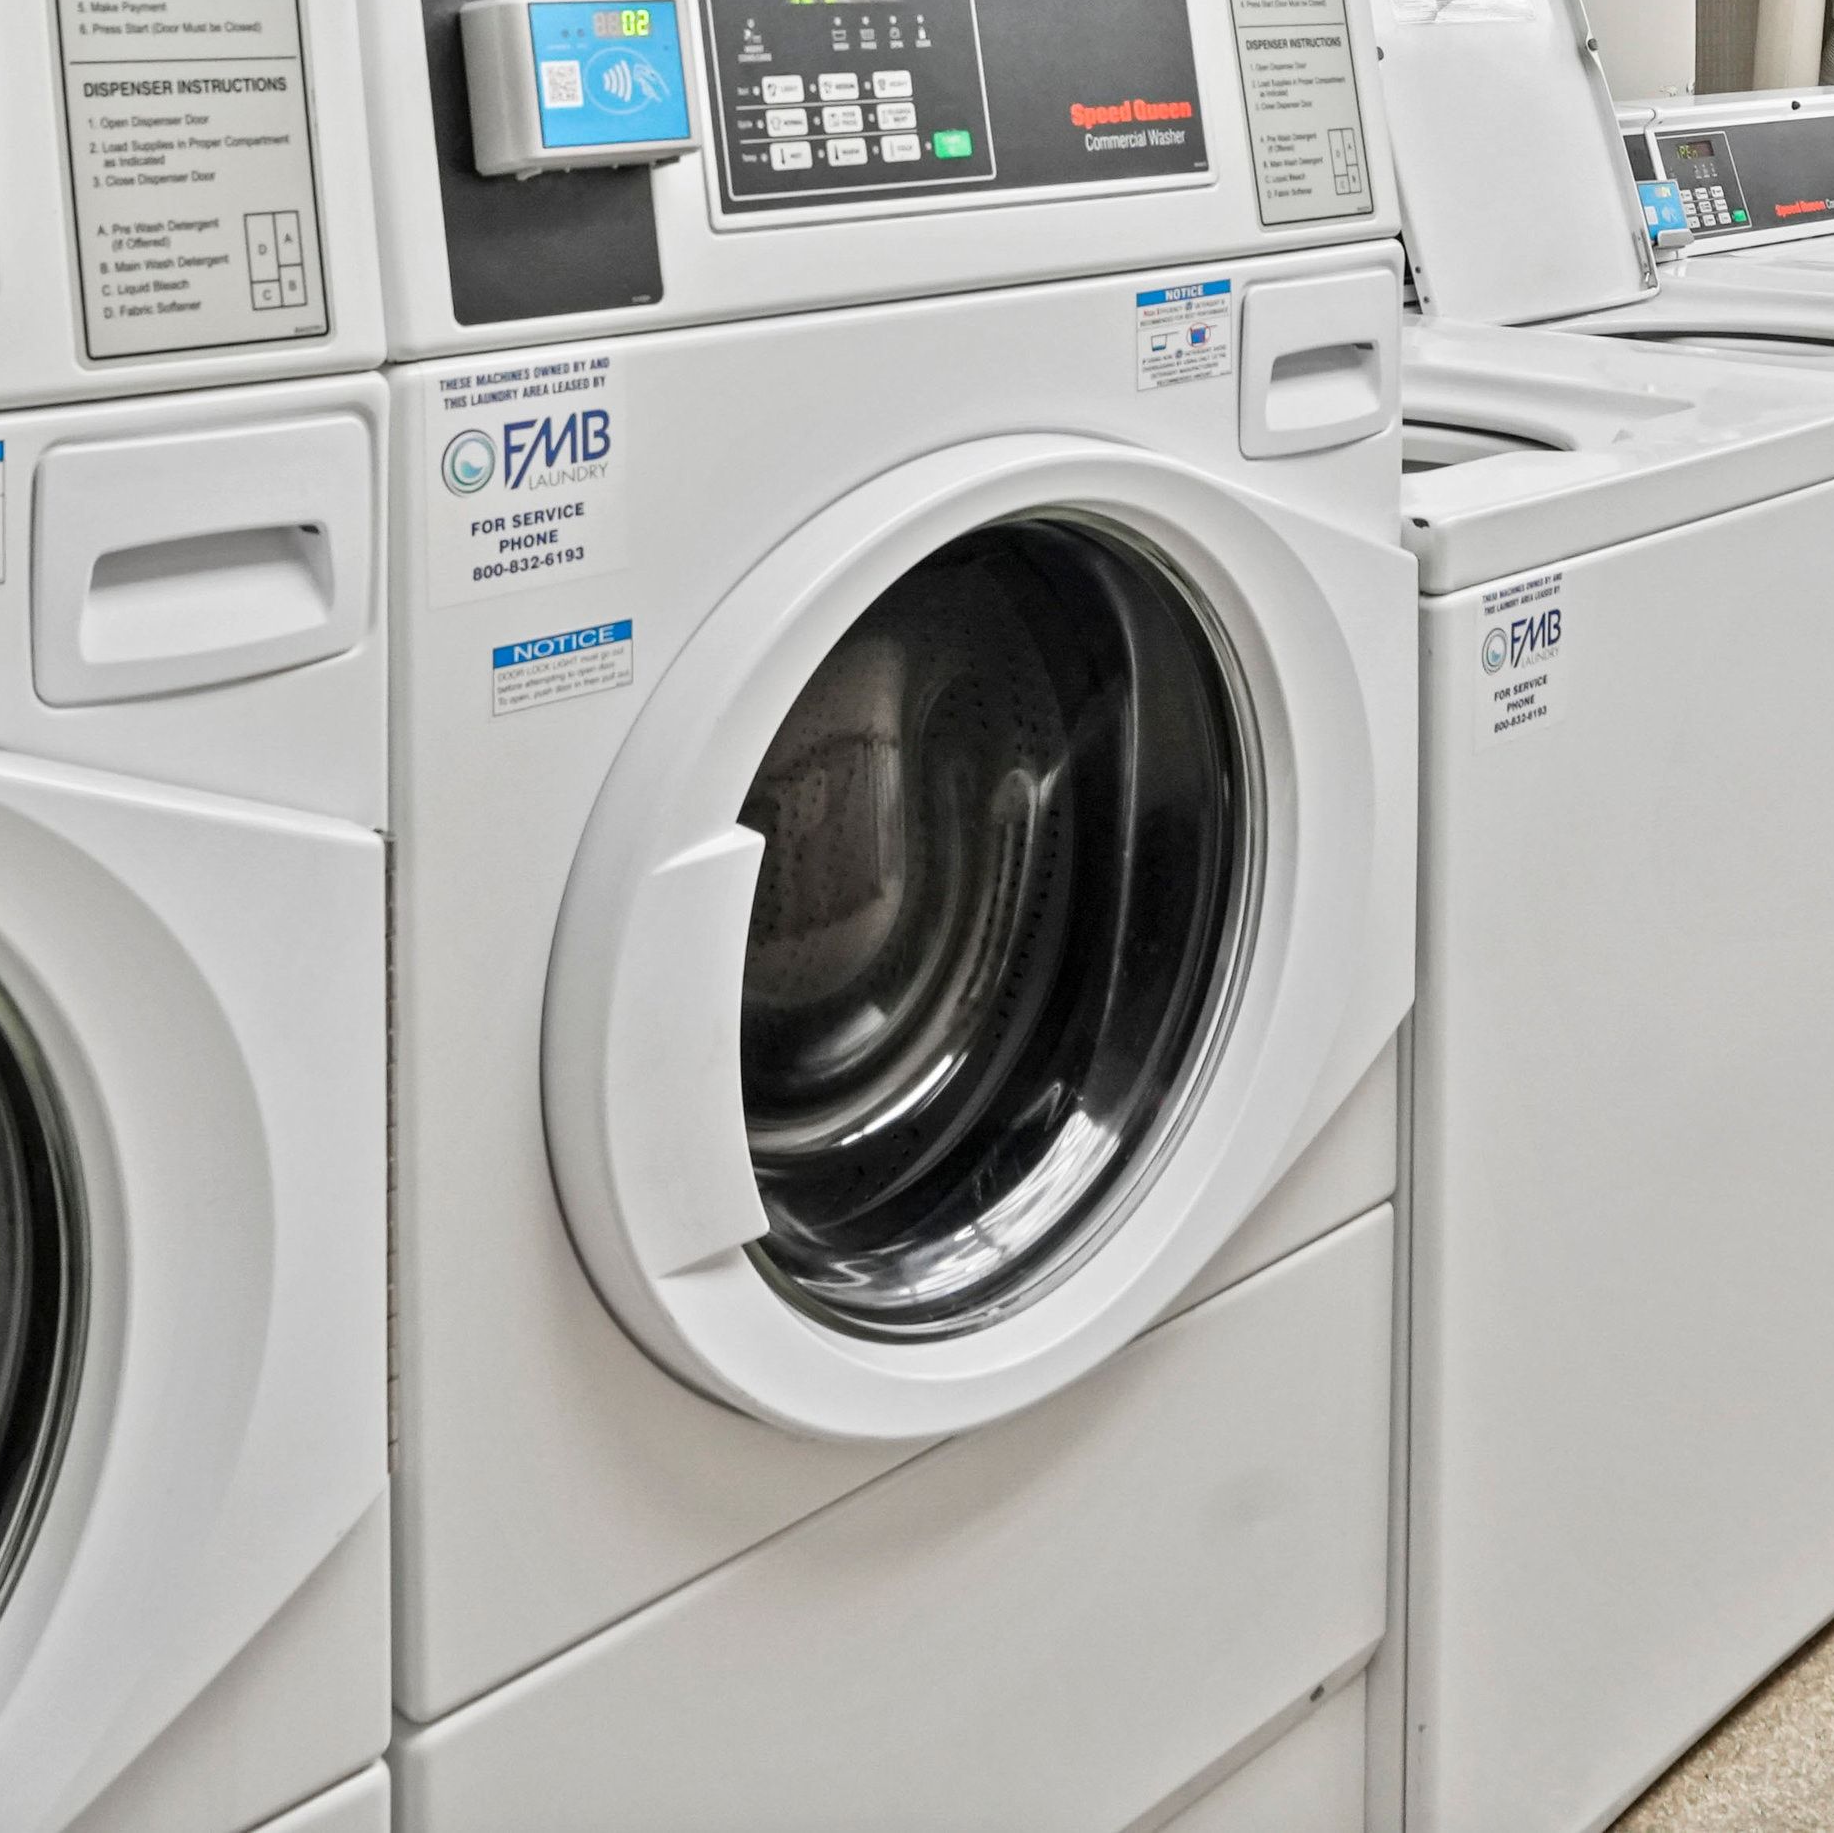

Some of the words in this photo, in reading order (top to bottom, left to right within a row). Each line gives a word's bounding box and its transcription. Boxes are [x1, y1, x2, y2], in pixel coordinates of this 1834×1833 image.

[621, 9, 650, 37] 02
[1246, 39, 1288, 50] DISPENSER
[1290, 37, 1342, 48] INSTRUCTIONS
[84, 80, 173, 97] DISPENSER
[177, 77, 287, 94] INSTRUCTIONS
[1071, 101, 1132, 129] Speed
[1133, 98, 1193, 123] Queen
[1085, 130, 1147, 151] Commercial
[1148, 127, 1185, 146] Washer
[258, 244, 267, 255] D
[1165, 285, 1204, 301] NOTICE
[440, 379, 472, 391] THESE
[476, 370, 530, 387] MACHINES
[534, 364, 570, 378] OWNED
[573, 361, 586, 372] BY
[589, 357, 610, 369] AND
[444, 397, 467, 410] THIS
[471, 389, 517, 406] LAUNDRY
[523, 385, 549, 399] AREA
[552, 377, 589, 394] LEASED
[593, 376, 606, 388] BY
[504, 409, 611, 490] FMB
[528, 462, 608, 491] LAUNDRY
[471, 518, 506, 537] FOR
[512, 502, 585, 528] SERVICE
[499, 529, 559, 553] PHONE
[473, 547, 585, 581] 800-832-6193
[513, 625, 615, 663] NOTICE
[1511, 609, 1561, 668] FMB
[1494, 686, 1511, 701] FOR
[1513, 674, 1548, 695] SERVICE
[1506, 694, 1535, 712] PHONE
